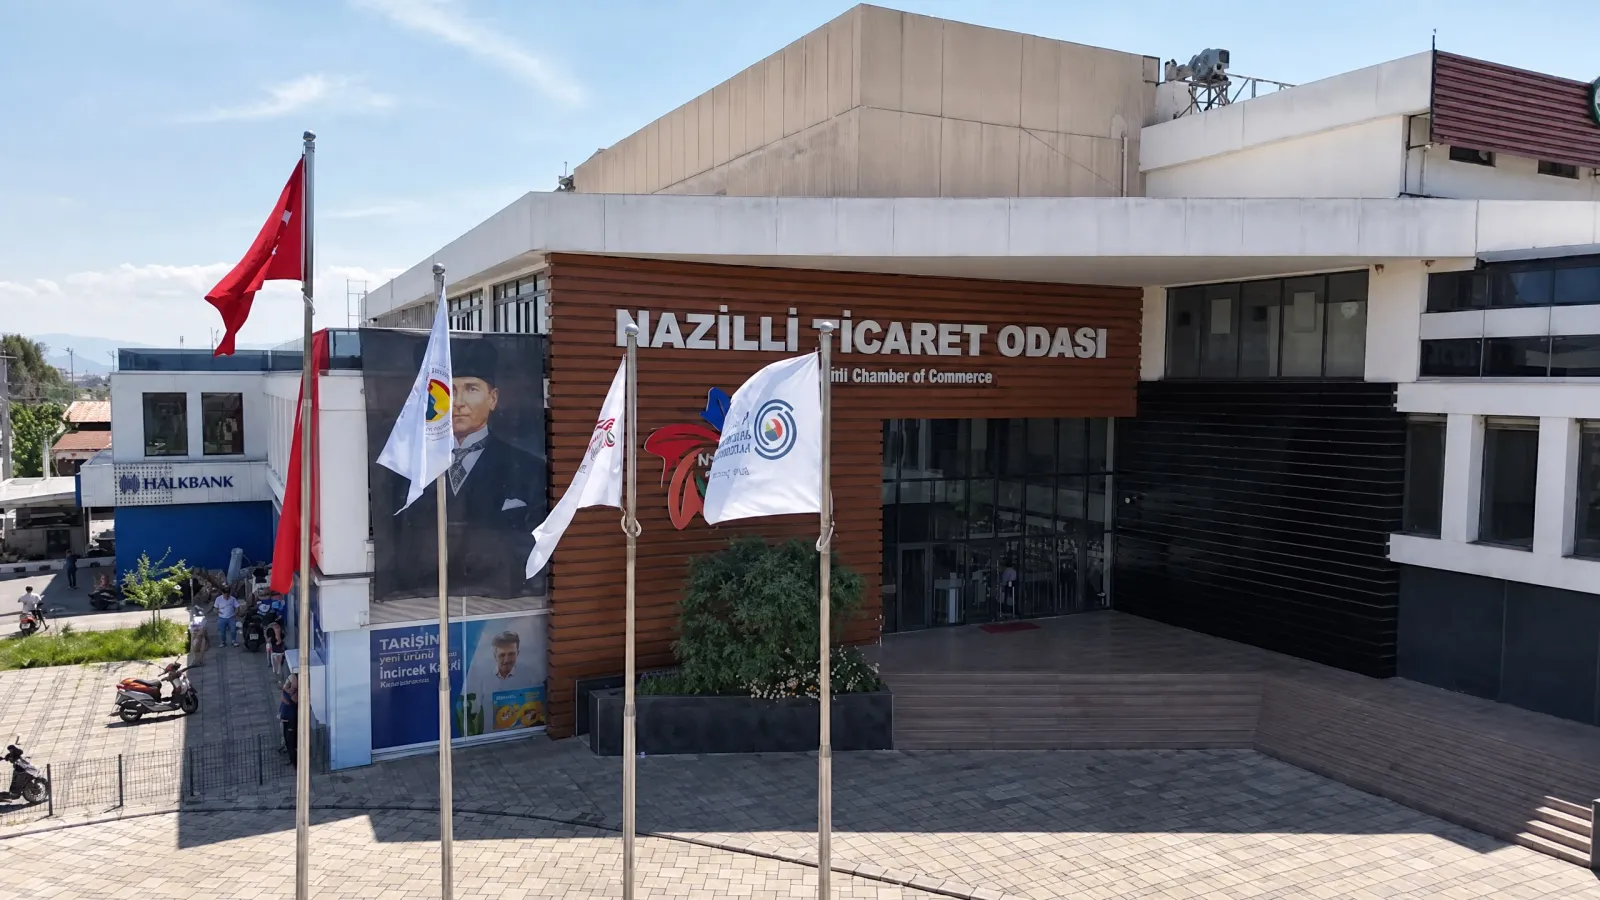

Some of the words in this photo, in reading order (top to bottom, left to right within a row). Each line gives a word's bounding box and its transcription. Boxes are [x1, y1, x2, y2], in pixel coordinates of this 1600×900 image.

[615, 304, 799, 352] NAZİLLİ
[997, 325, 1107, 359] ODASI
[852, 367, 910, 384] Chamber
[912, 368, 926, 384] of
[928, 369, 993, 384] Commerce
[144, 476, 234, 490] HALKBANK
[379, 653, 401, 666] yeni
[403, 650, 434, 662] ürünü
